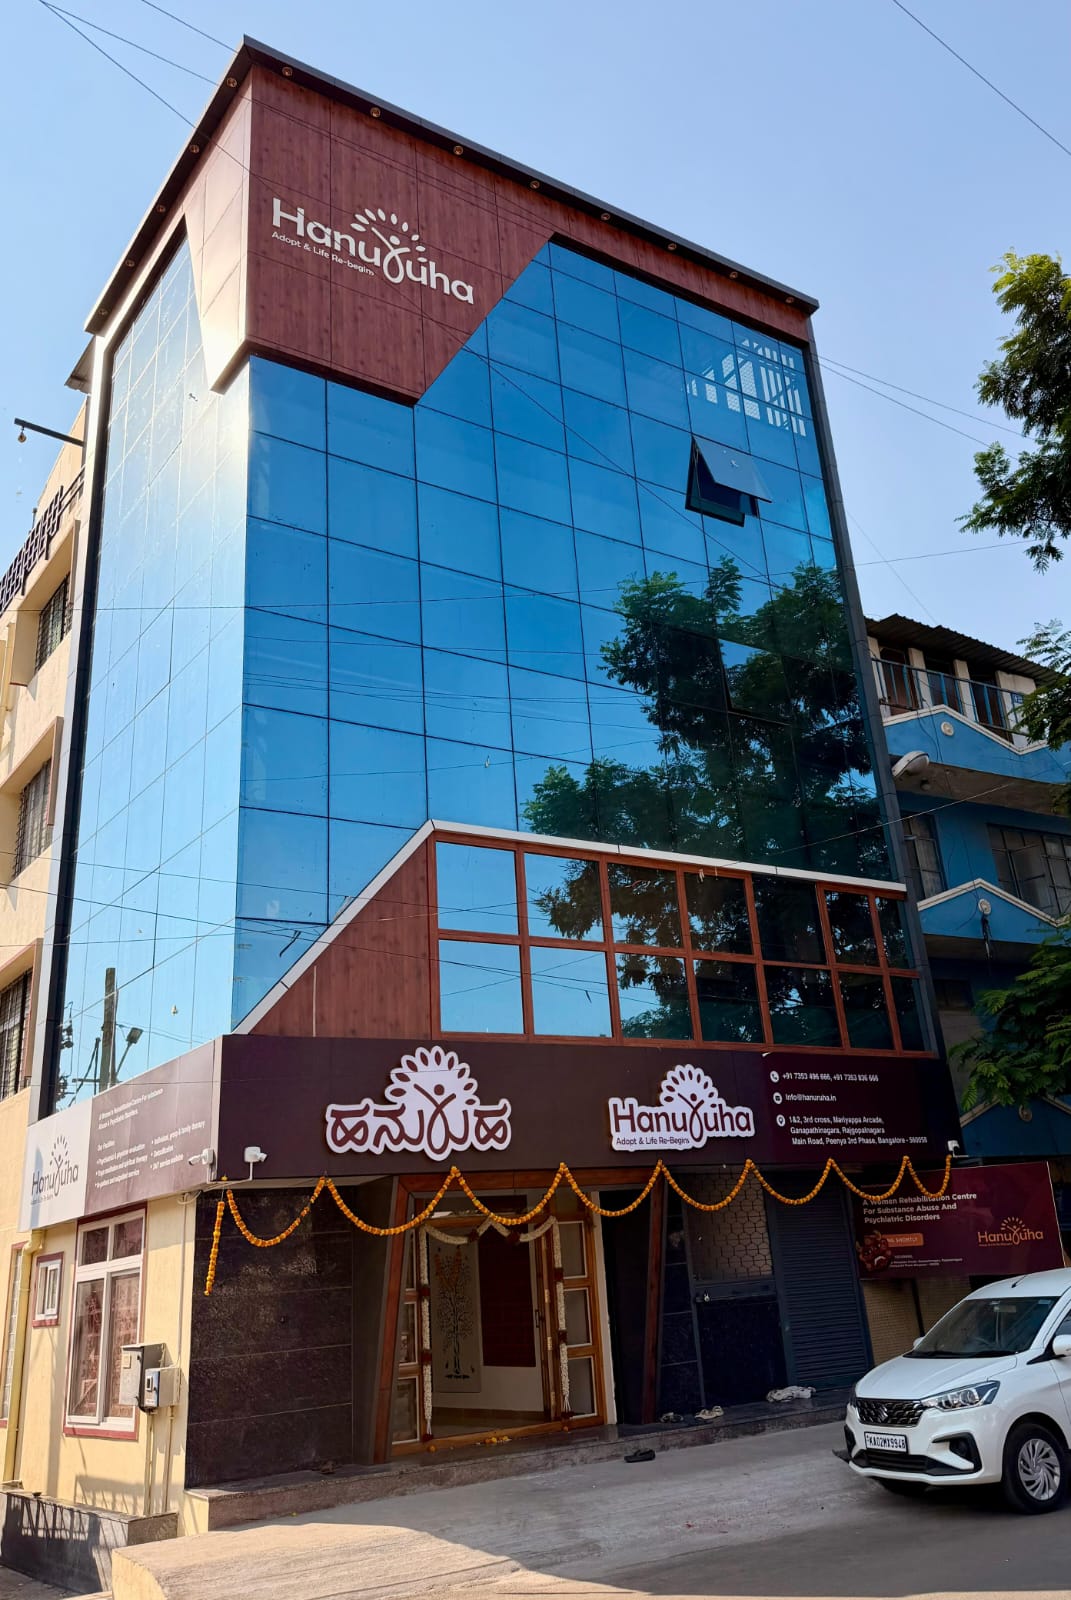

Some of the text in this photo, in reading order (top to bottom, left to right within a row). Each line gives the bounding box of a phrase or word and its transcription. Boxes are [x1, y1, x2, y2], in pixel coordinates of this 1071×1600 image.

[271, 231, 302, 248] Adopt
[303, 243, 312, 251] &
[313, 246, 330, 258] Life
[802, 1115, 814, 1123] 3rd
[814, 1117, 833, 1125] cross,
[616, 1137, 637, 1146] Adopt
[639, 1136, 645, 1144] &
[645, 1136, 658, 1145] Life
[791, 1137, 807, 1145] Main
[807, 1137, 825, 1146] Road,
[877, 1136, 906, 1146] Bangalore
[951, 1193, 977, 1201] Centre
[877, 1206, 915, 1214] Substance
[916, 1204, 940, 1212] Abuse
[941, 1202, 957, 1210] And
[864, 1213, 941, 1225] Psychiatric Disorders
